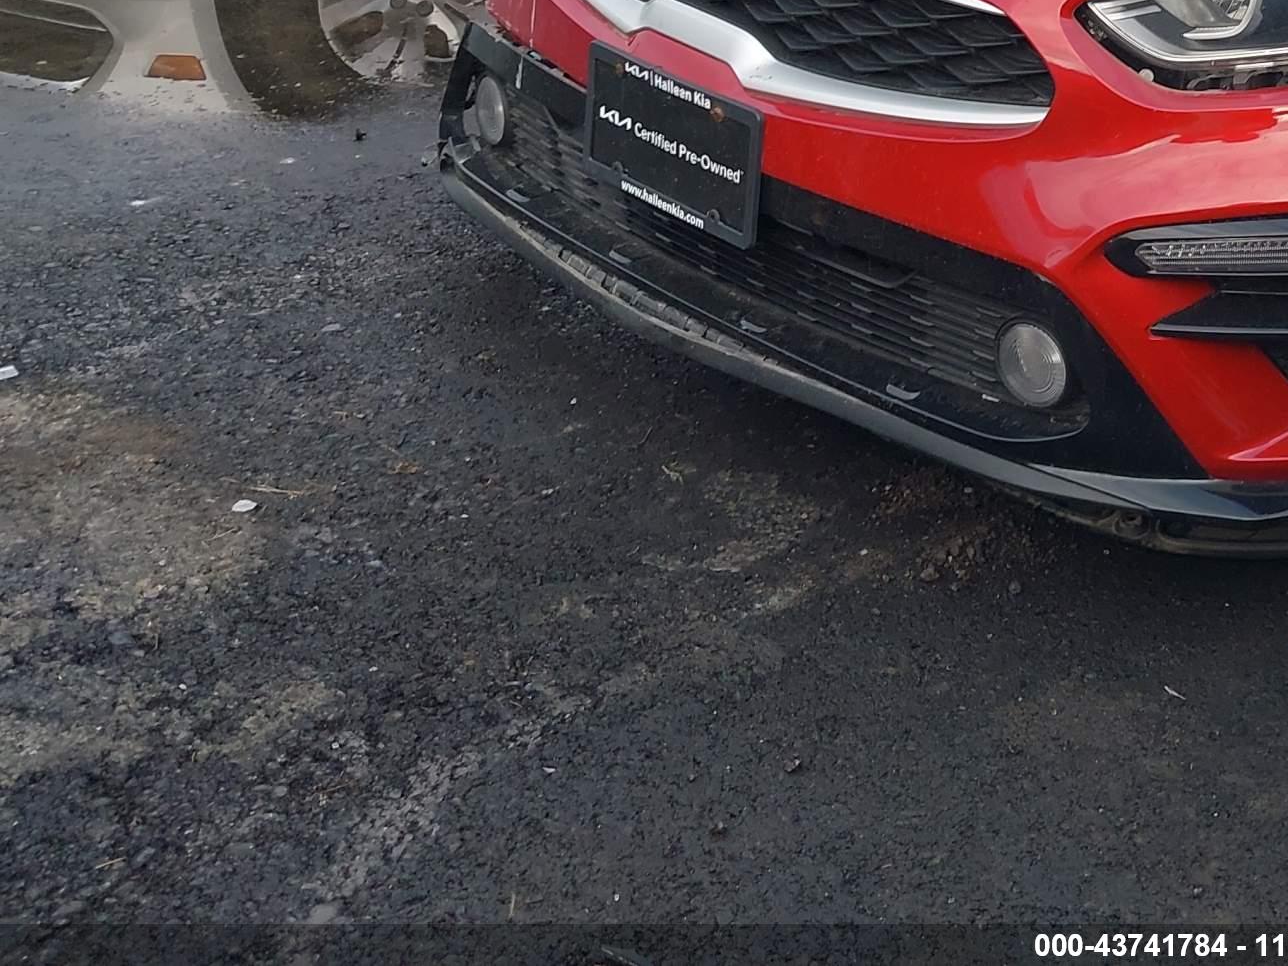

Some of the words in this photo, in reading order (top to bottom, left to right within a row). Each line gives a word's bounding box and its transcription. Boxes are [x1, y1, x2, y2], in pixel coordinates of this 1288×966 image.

[693, 90, 711, 110] Kia
[634, 122, 677, 156] Certified
[678, 144, 741, 184] Pre-Owned
[620, 180, 704, 230] www.halleenkia.com
